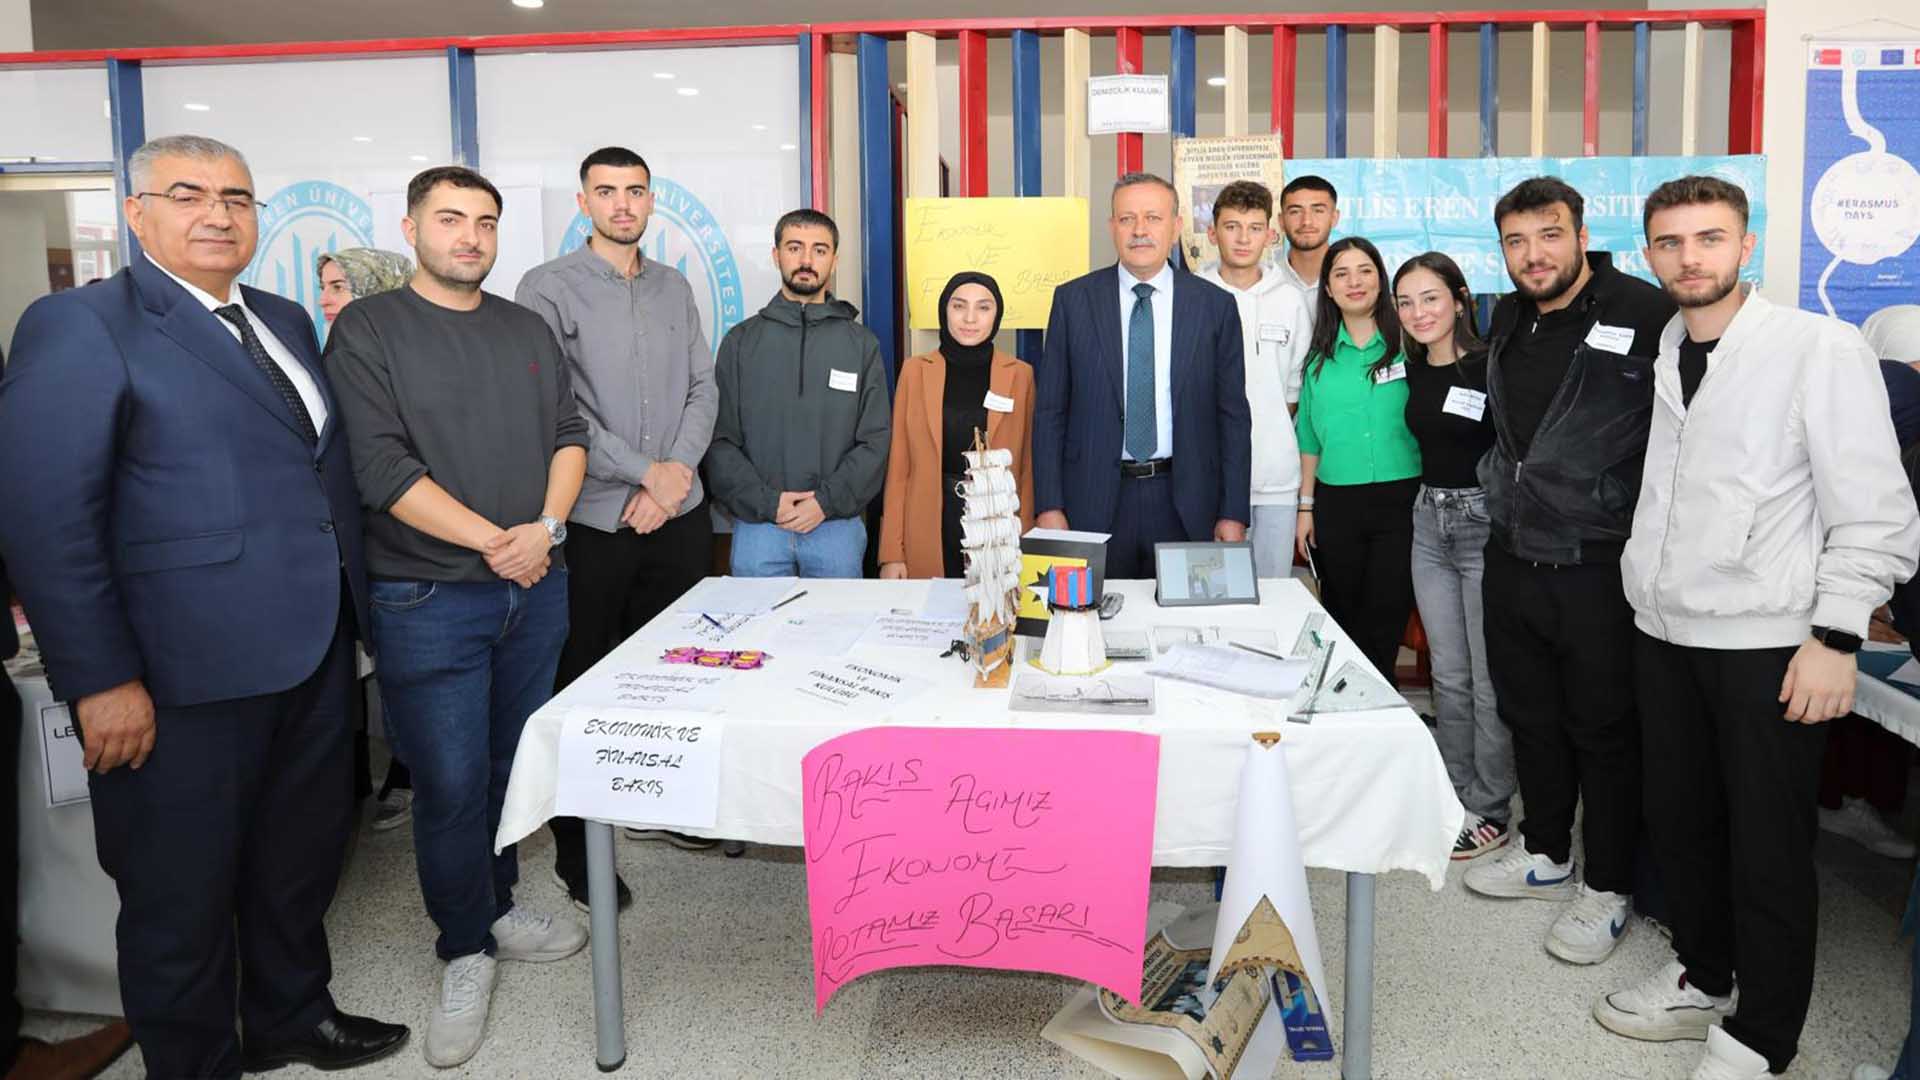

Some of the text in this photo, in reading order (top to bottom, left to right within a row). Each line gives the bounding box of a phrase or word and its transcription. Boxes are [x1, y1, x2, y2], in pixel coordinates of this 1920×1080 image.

[1339, 191, 1396, 218] TLİS
[1406, 197, 1479, 218] EREN
[1837, 199, 1899, 209] #ERASMUS
[1844, 210, 1874, 220] DAYS
[584, 719, 702, 742] EKONOMİK VE
[595, 746, 684, 768] FİNANSAL
[611, 777, 664, 798] BAKIŞ
